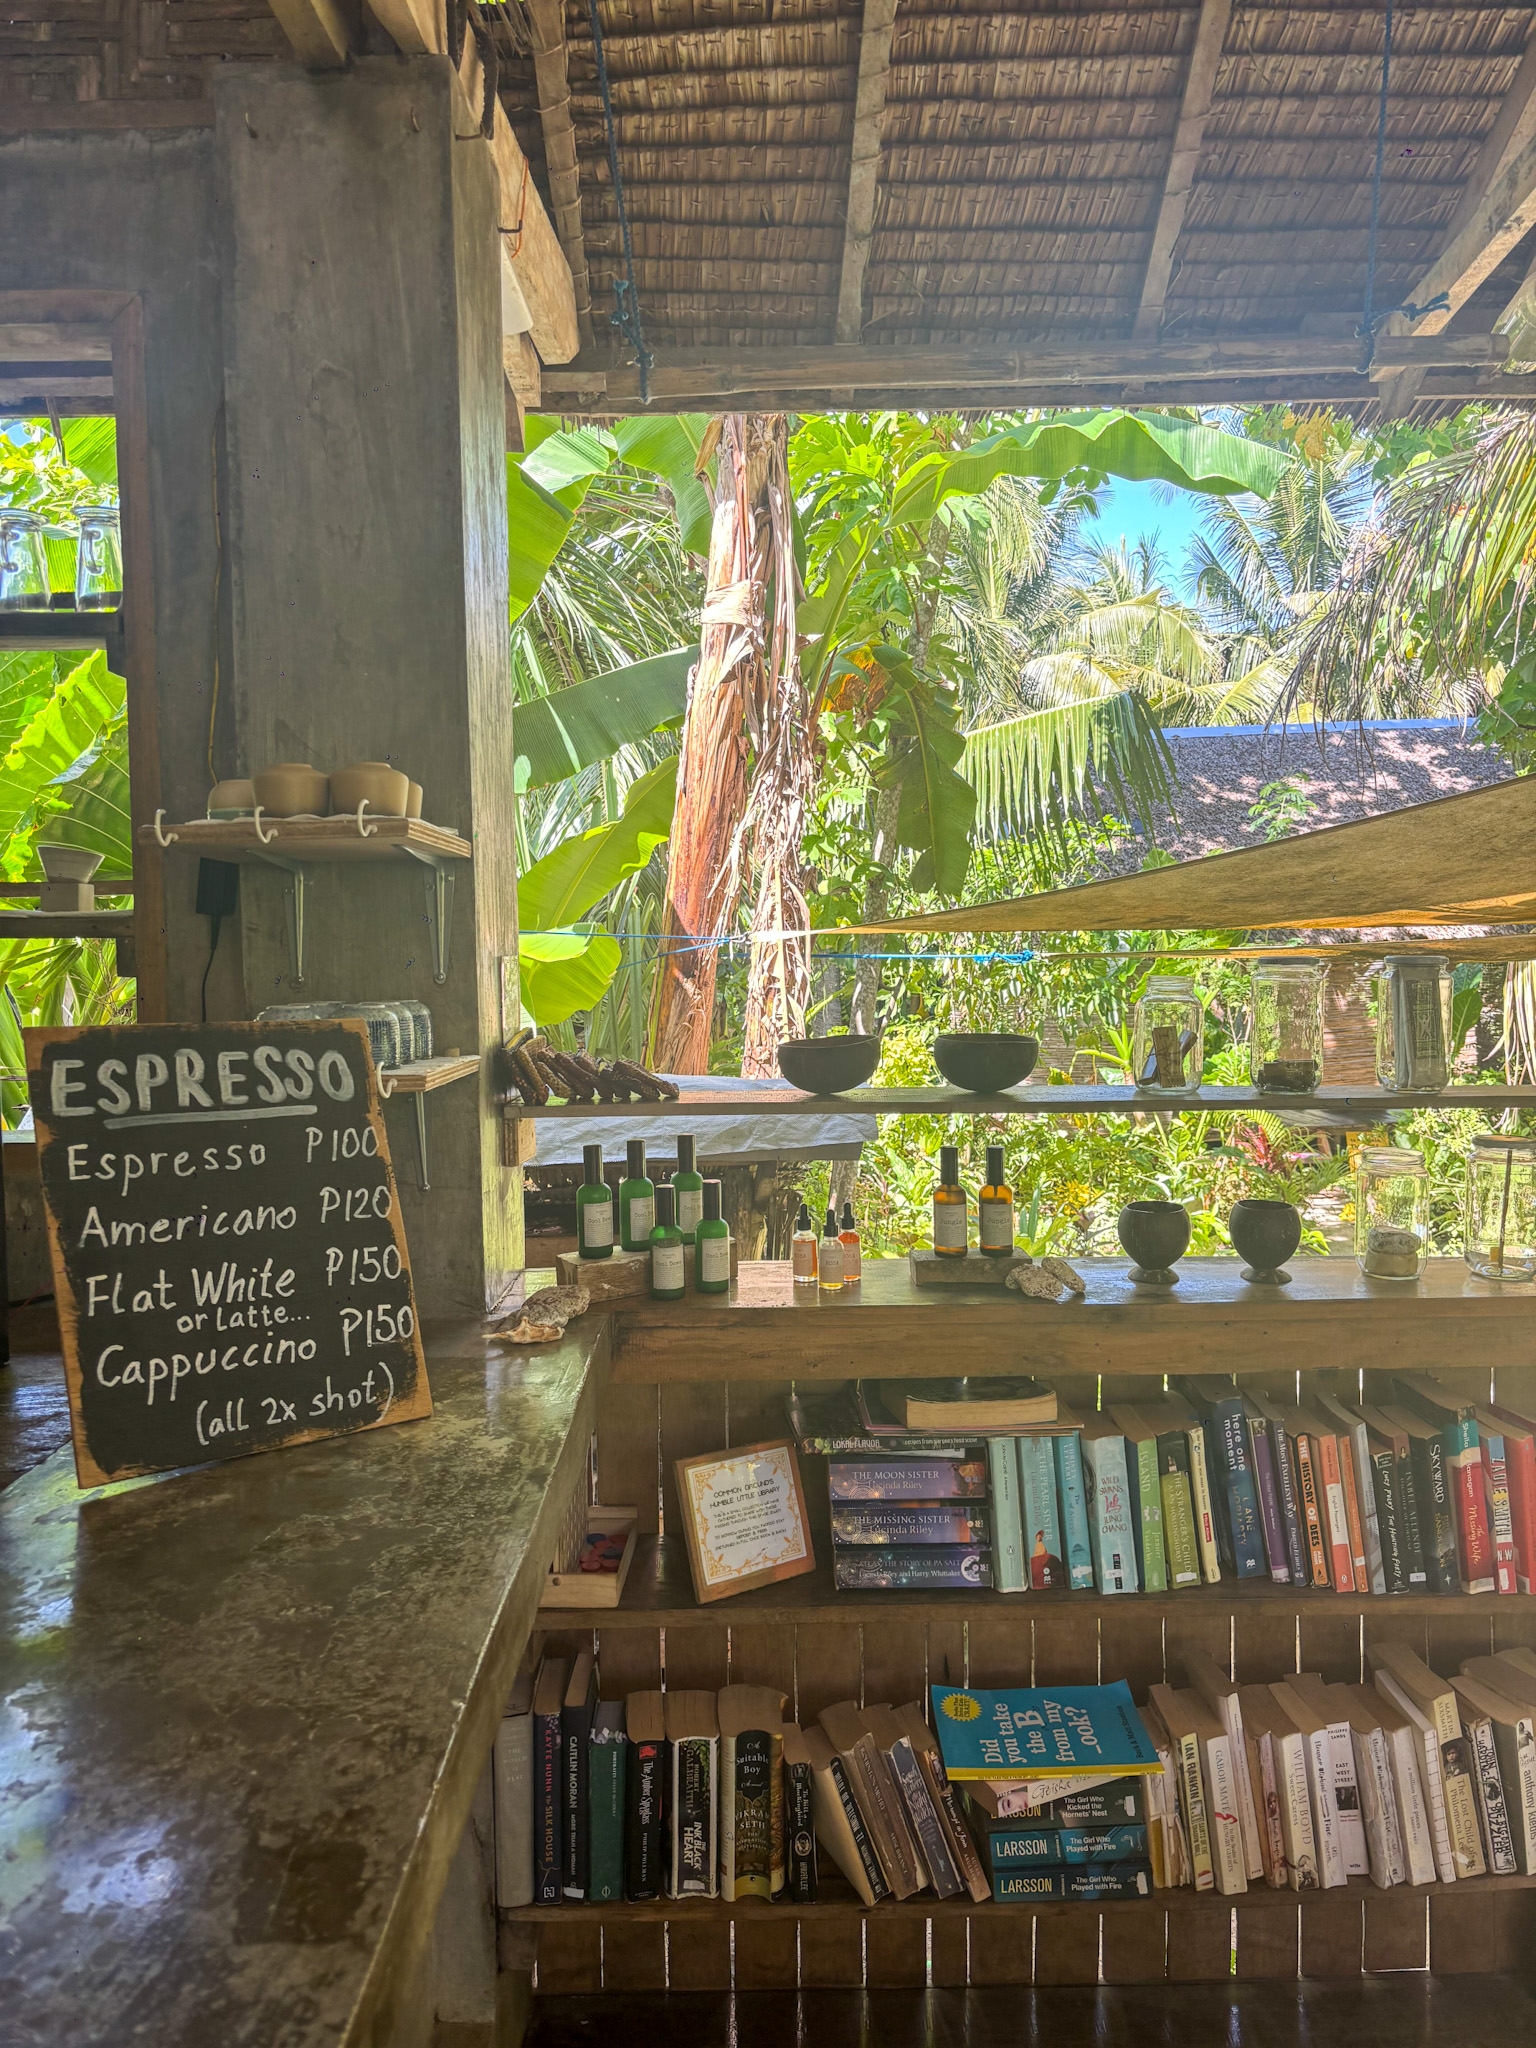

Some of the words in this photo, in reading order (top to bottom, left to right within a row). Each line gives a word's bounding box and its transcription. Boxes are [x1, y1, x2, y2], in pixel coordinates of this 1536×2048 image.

[51, 1046, 355, 1117] ESPRESSO
[67, 1143, 267, 1196] Espresso
[79, 1205, 297, 1248] Americano
[939, 1218, 963, 1227] Jungle
[987, 1217, 1010, 1226] Jungle
[86, 1269, 177, 1317] Flat
[191, 1258, 296, 1307] White
[177, 1312, 207, 1334] or
[97, 1332, 317, 1405] Cappuccino
[196, 1397, 249, 1446] (all
[266, 1397, 296, 1425] 2x
[309, 1361, 394, 1423] shot)
[1231, 1413, 1242, 1443] here
[1224, 1419, 1238, 1471] moment
[1279, 1443, 1288, 1463] MOST
[1299, 1440, 1308, 1459] THE
[1039, 1455, 1048, 1474] THE
[1139, 1450, 1151, 1492] ISLAND
[1236, 1447, 1246, 1471] one
[853, 1471, 871, 1480] THE
[874, 1471, 905, 1480] MOON
[908, 1470, 939, 1479] SISTER
[869, 1480, 901, 1489] Lucinda
[902, 1480, 923, 1491] Riley
[1101, 1476, 1119, 1485] WILD
[1174, 1472, 1182, 1487] THE
[1281, 1463, 1292, 1501] EXCELLENT
[1302, 1462, 1314, 1504] HISTORY
[1382, 1470, 1391, 1486] LUCY
[1430, 1444, 1445, 1504] SKYWARD
[709, 1497, 734, 1509] HUMBLE
[736, 1492, 755, 1502] LITTLE
[757, 1486, 781, 1497] LIBRARY
[713, 1487, 742, 1499] COMMON
[1040, 1477, 1050, 1506] PEARL
[1100, 1485, 1124, 1495] SWANS
[1384, 1488, 1394, 1511] FOLEY
[852, 1516, 871, 1524] THE
[874, 1516, 916, 1524] MISSING
[918, 1515, 950, 1524] SISTER
[1043, 1509, 1053, 1541] SISTER
[1104, 1515, 1123, 1526] JUNG
[1175, 1489, 1189, 1542] STRANGER'S
[1308, 1507, 1317, 1521] OF
[1467, 1505, 1478, 1541] Missing
[870, 1525, 907, 1534] Lucinda
[909, 1525, 934, 1535] Riley
[1102, 1524, 1127, 1534] CHANG
[1182, 1542, 1192, 1571] CHILD
[1470, 1541, 1482, 1565] Wife
[992, 1703, 1011, 1736] take
[1013, 1709, 1045, 1729] B
[1043, 1699, 1062, 1723] my
[1437, 1701, 1448, 1740] SIXSMITH
[1444, 1702, 1454, 1734] MARTIN
[544, 1730, 553, 1761] KAYTE
[569, 1736, 578, 1771] CAITLIN
[979, 1738, 1004, 1764] Did
[1004, 1737, 1028, 1764] you
[1027, 1730, 1047, 1754] the
[1052, 1727, 1076, 1762] from
[1184, 1742, 1194, 1760] IAN
[643, 1761, 653, 1774] The
[744, 1765, 761, 1775] Boy
[1215, 1749, 1226, 1783] GABOR
[1293, 1749, 1306, 1807] WILLIAM
[569, 1773, 578, 1809] MORAN
[1187, 1762, 1200, 1803] RANKIN
[1456, 1778, 1465, 1797] The
[1523, 1769, 1536, 1809] anthony
[544, 1805, 554, 1829] SILK
[639, 1796, 653, 1825] Spyglass
[1450, 1789, 1462, 1835] Philomena
[1460, 1797, 1469, 1816] Lost
[694, 1821, 702, 1840] INK
[739, 1819, 765, 1829] SETH
[1299, 1809, 1312, 1845] BOYD
[1463, 1817, 1474, 1843] Child
[544, 1829, 553, 1863] HOUSE
[683, 1827, 694, 1867] HEART
[694, 1840, 702, 1871] BLACK
[996, 1839, 1048, 1857] LARSSON
[1066, 1845, 1088, 1853] Played
[1468, 1843, 1475, 1855] of
[1000, 1877, 1053, 1895] LARSSON
[1071, 1883, 1094, 1891] Played
